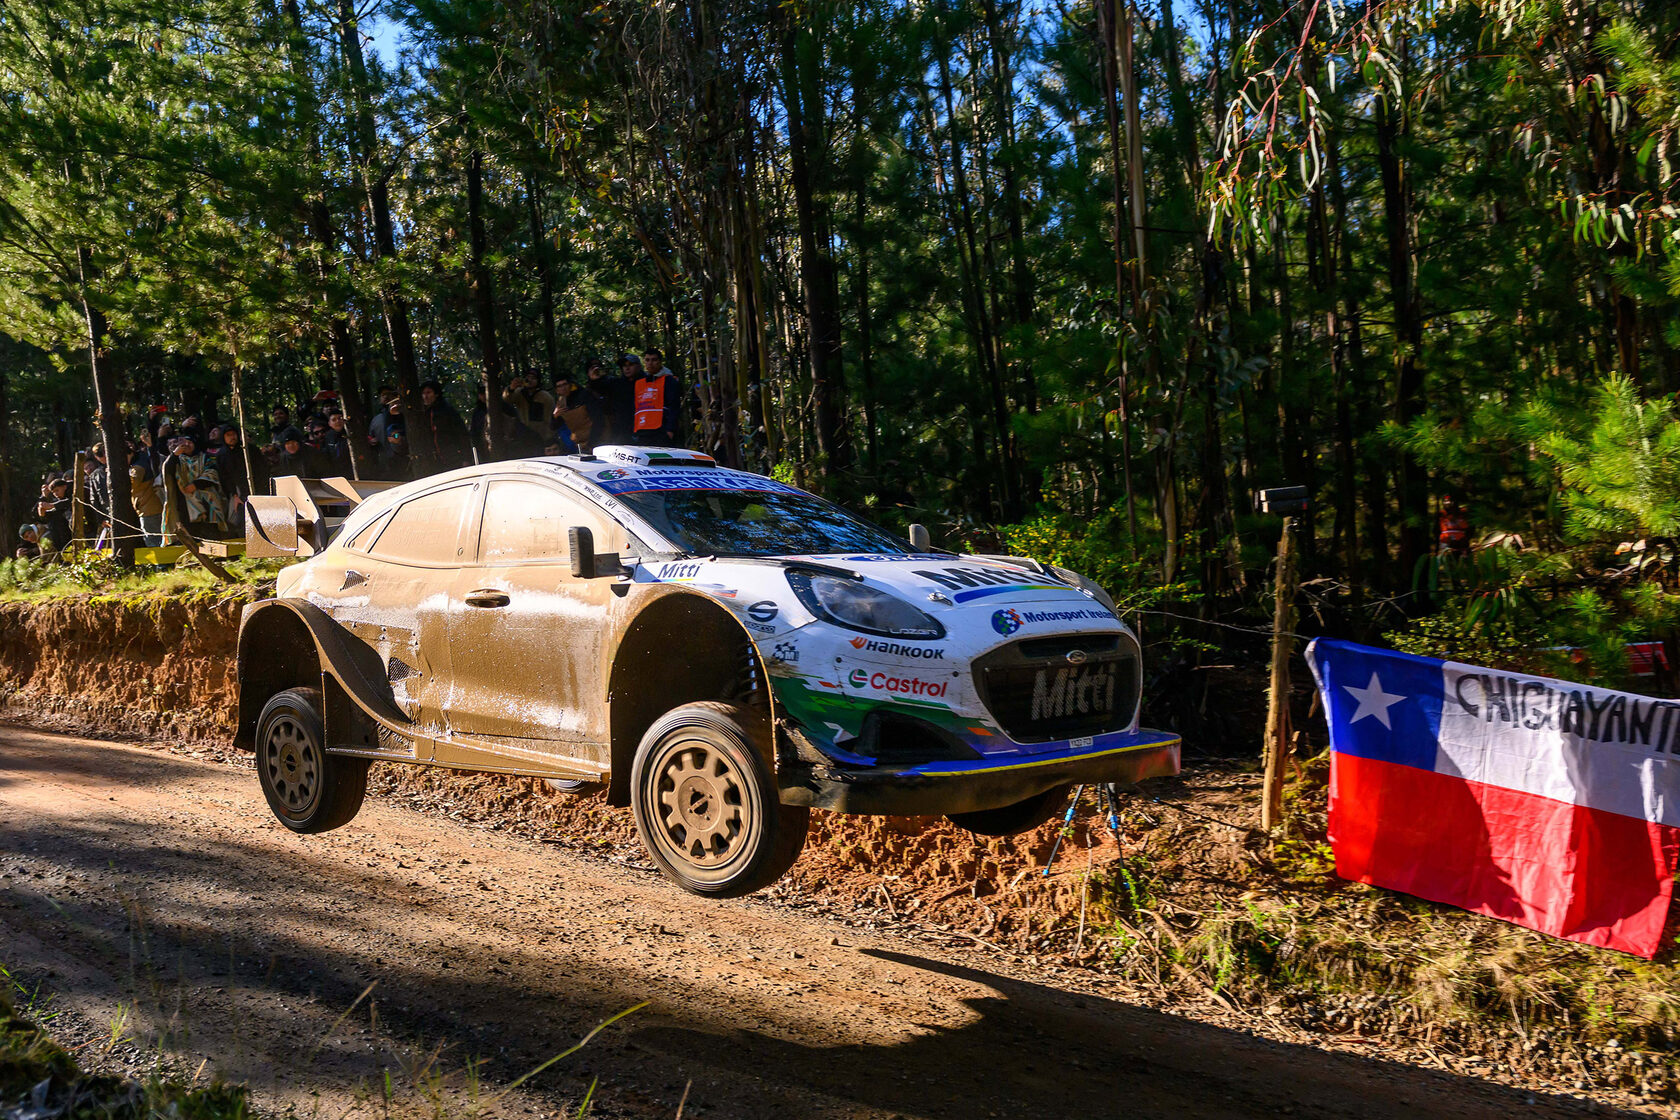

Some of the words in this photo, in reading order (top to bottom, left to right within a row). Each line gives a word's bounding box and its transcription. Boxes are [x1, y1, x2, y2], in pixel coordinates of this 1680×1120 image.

[635, 469, 726, 479] Motorsport
[657, 563, 703, 579] Mitti
[1022, 609, 1088, 623] Motorsport
[870, 672, 948, 697] Castrol
[1031, 663, 1116, 720] Mitti
